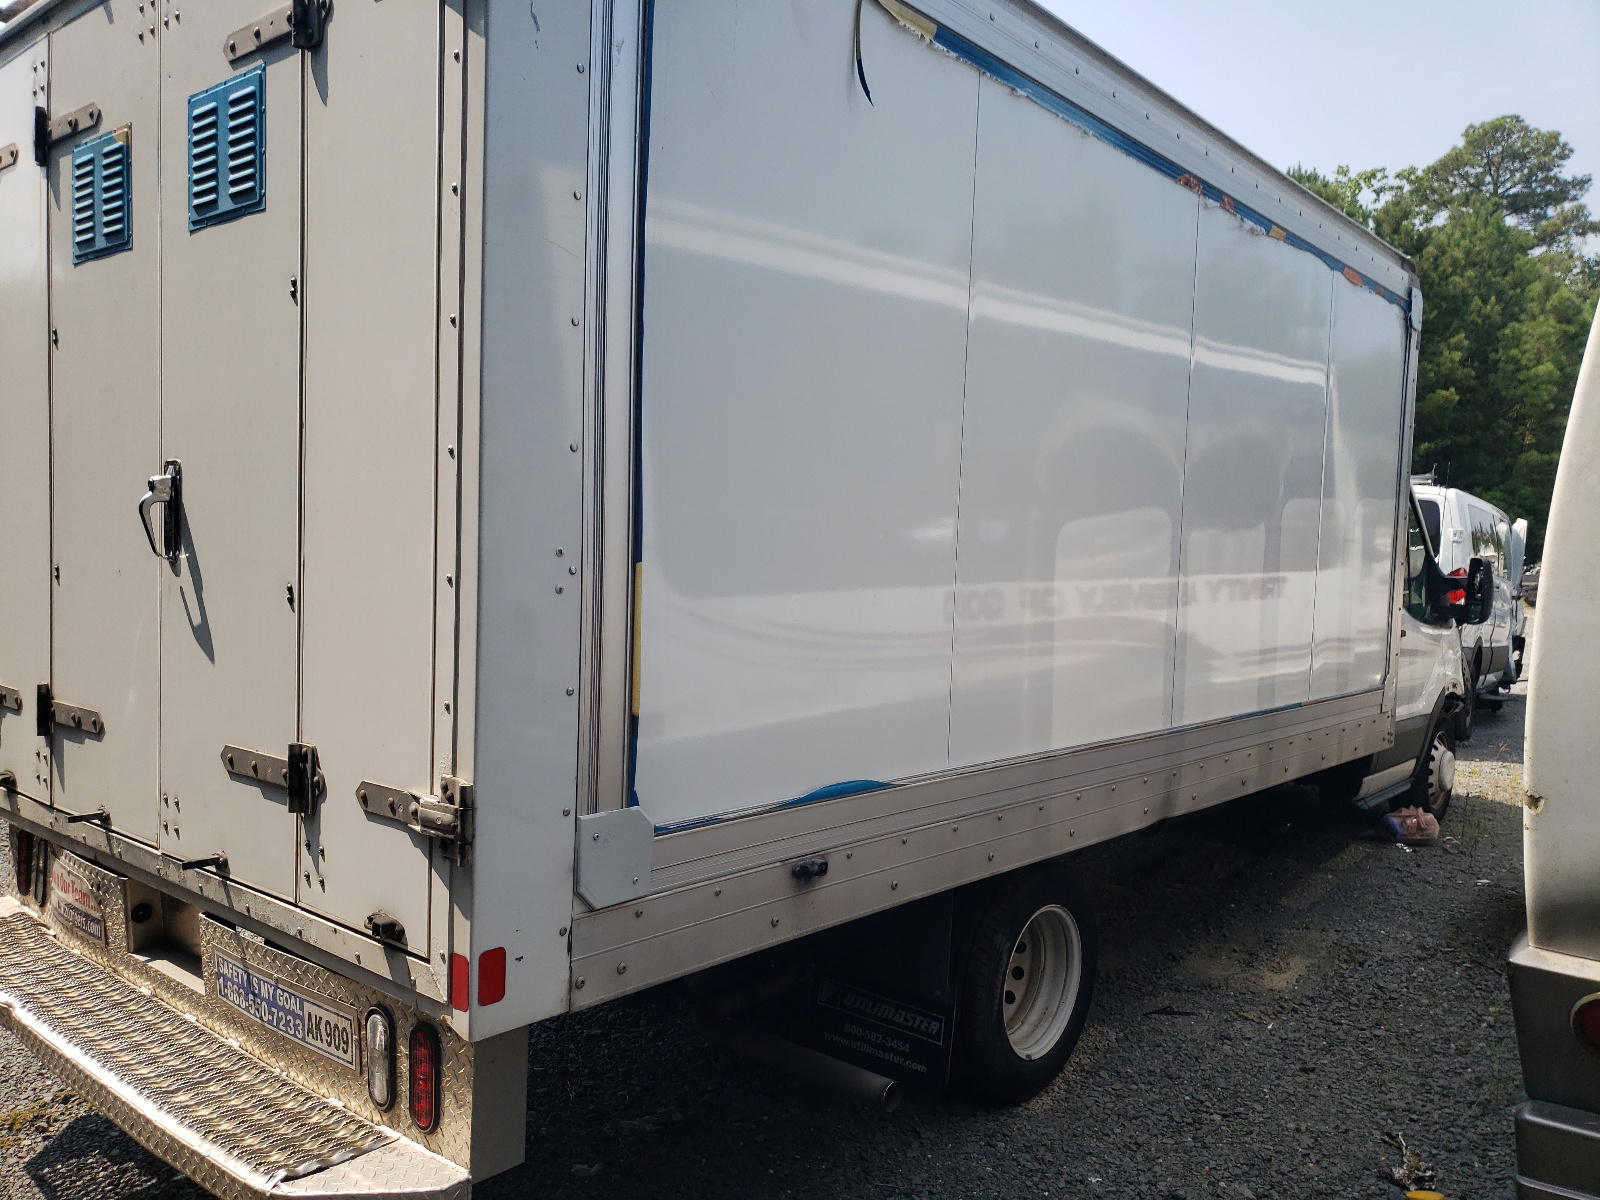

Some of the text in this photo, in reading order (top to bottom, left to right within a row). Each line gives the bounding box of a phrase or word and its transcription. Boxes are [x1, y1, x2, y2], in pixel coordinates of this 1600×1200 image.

[59, 872, 71, 894] Our
[218, 956, 303, 1016] SAFETY IS MY GOAL
